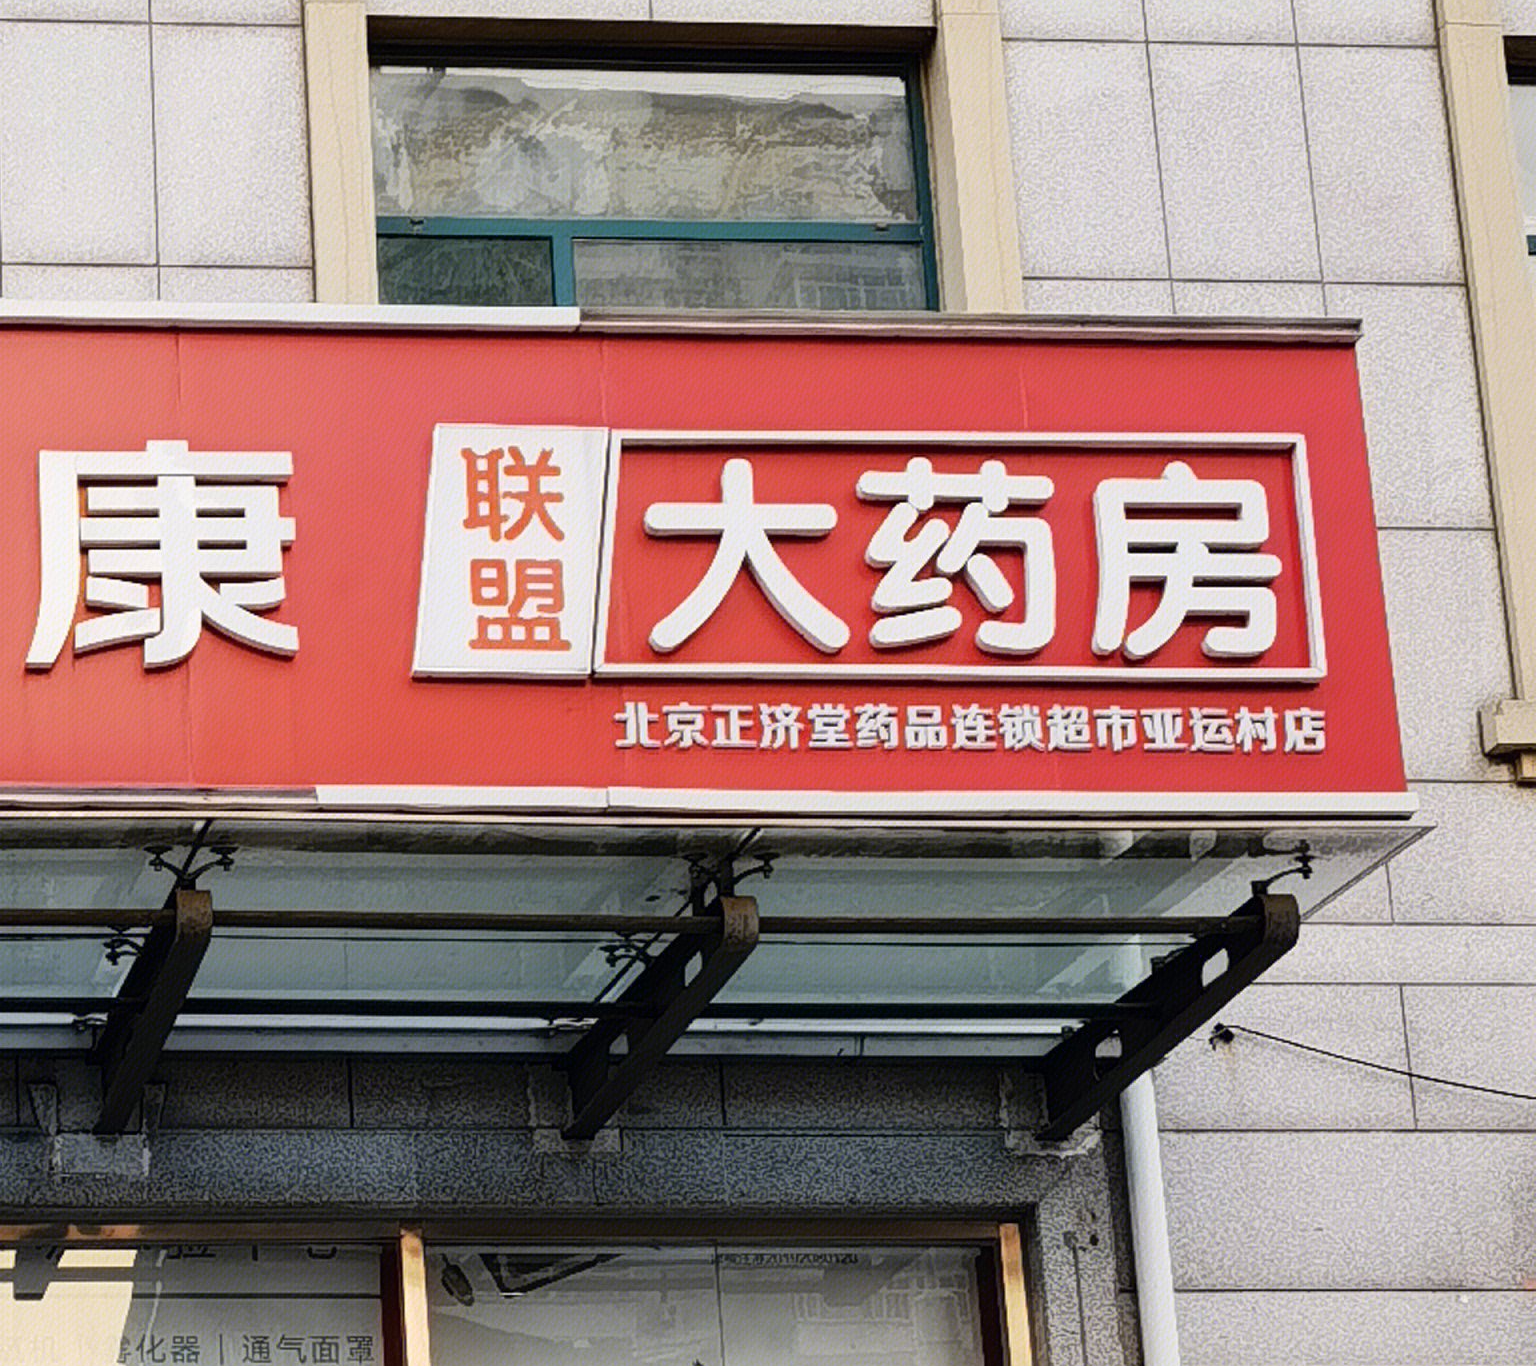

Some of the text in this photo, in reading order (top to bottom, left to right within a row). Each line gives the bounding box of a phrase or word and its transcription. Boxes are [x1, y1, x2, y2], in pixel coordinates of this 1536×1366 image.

[460, 447, 571, 651] 联盟
[642, 457, 1282, 660] 大药房
[614, 701, 1327, 753] 北京正济堂药品连锁超市亚运村店
[242, 1334, 376, 1365] 通气面罩
